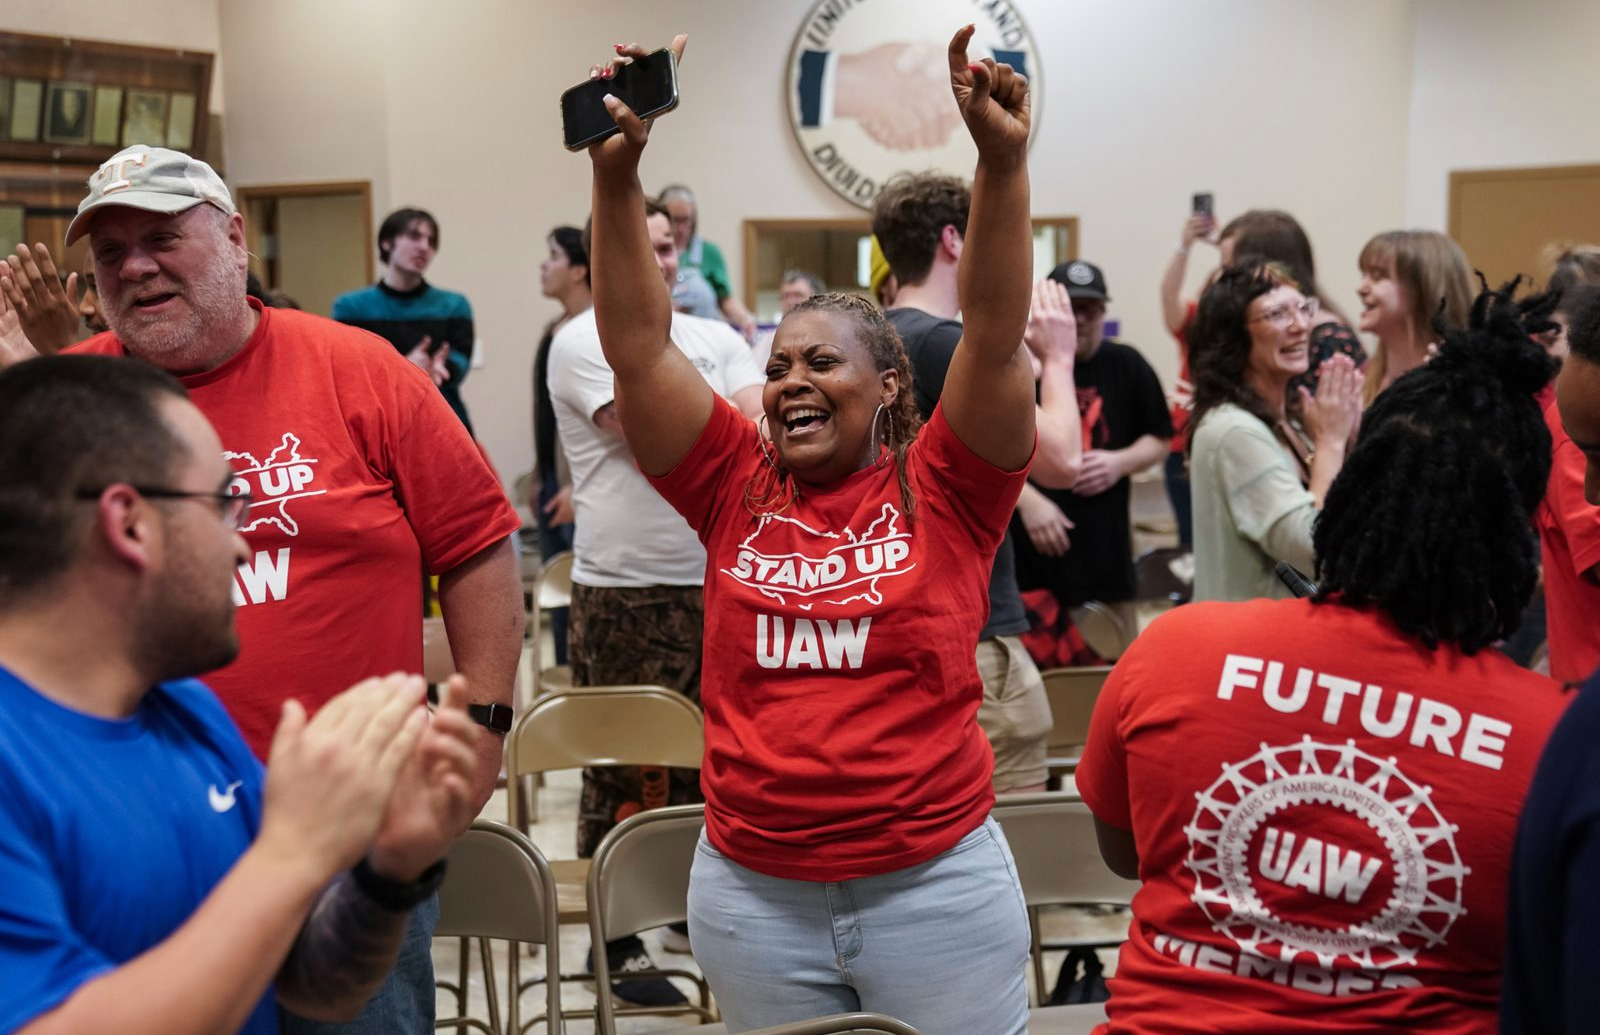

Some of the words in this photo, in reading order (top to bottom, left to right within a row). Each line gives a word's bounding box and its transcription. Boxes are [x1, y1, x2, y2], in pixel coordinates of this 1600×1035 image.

[976, 0, 1023, 48] AND
[98, 153, 148, 195] T
[259, 464, 314, 496] UP
[731, 550, 847, 589] STAND
[854, 540, 910, 574] UP
[756, 614, 872, 669] UAW
[1217, 654, 1512, 770] FUTURE
[1260, 786, 1279, 803] OF
[1280, 781, 1338, 796] AMERICA
[1341, 786, 1387, 818] UNITED
[1222, 797, 1263, 843] WORKERS
[1258, 827, 1383, 905] UAW
